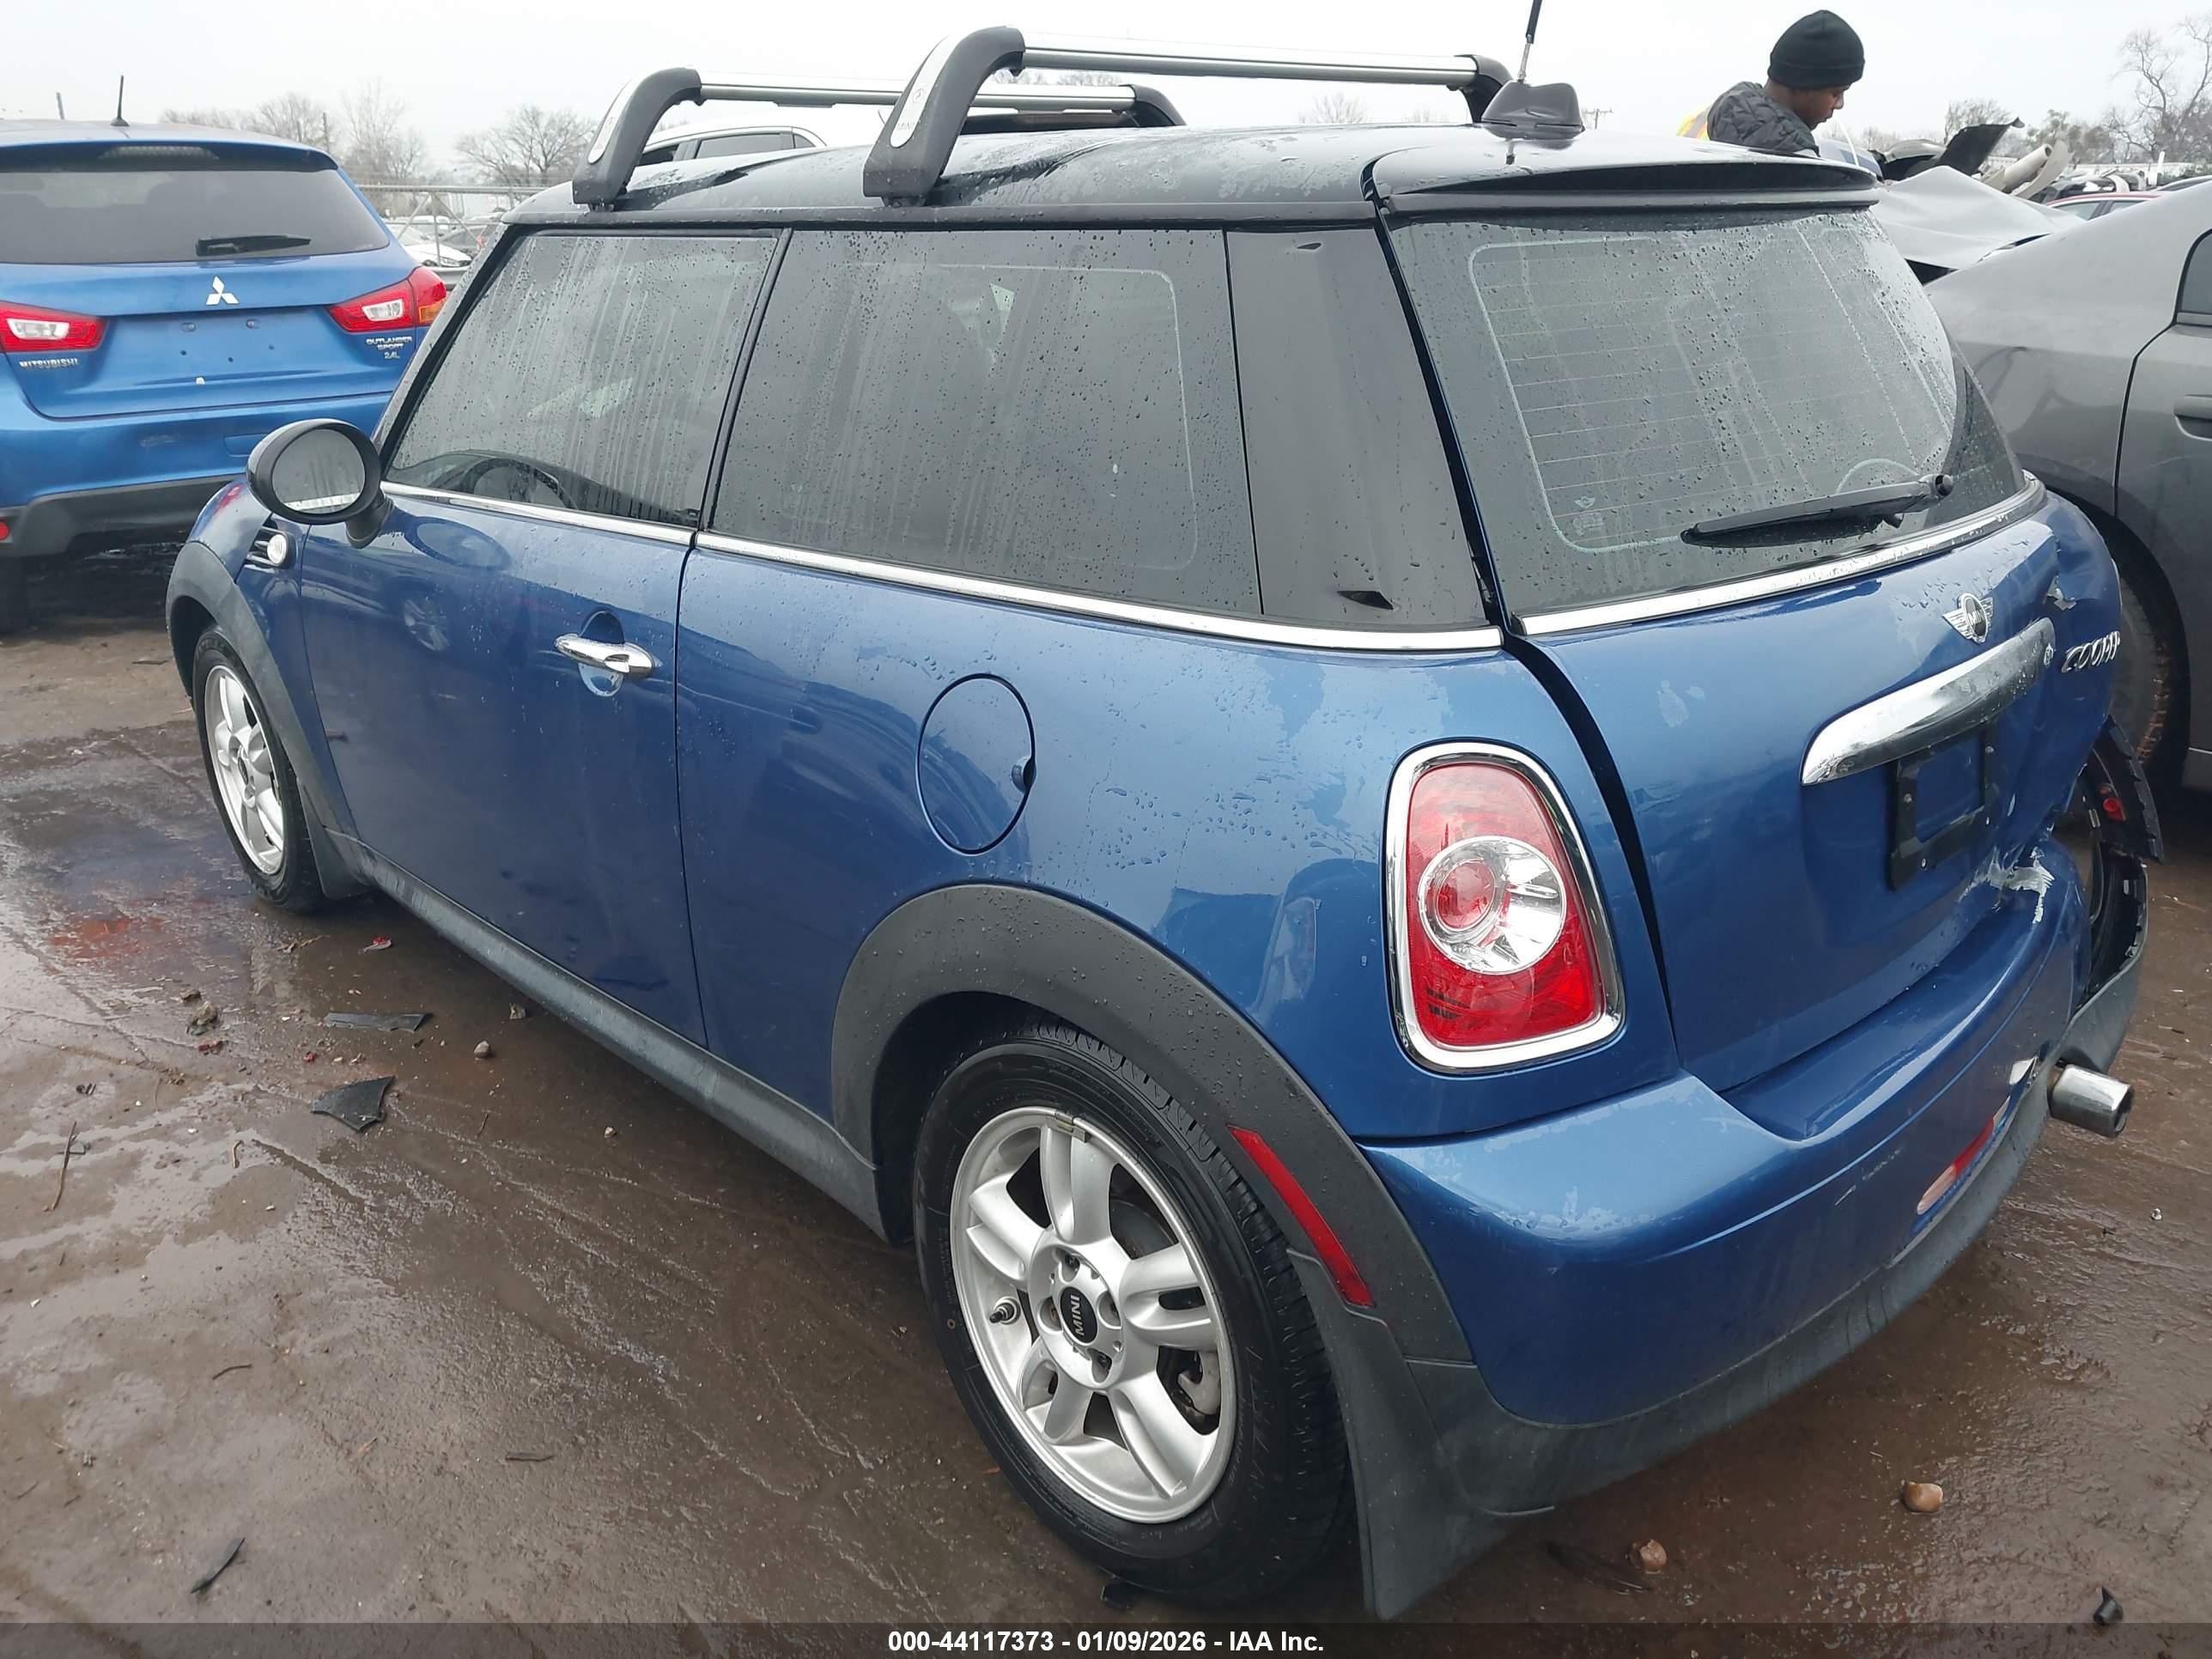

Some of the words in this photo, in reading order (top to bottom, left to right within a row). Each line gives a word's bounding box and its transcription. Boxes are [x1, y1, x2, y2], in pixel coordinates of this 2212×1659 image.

[366, 336, 413, 345] OUTLANDER
[377, 343, 405, 351] SPORT
[19, 357, 79, 369] MITSUBISHI
[1070, 1294, 1085, 1336] MINI
